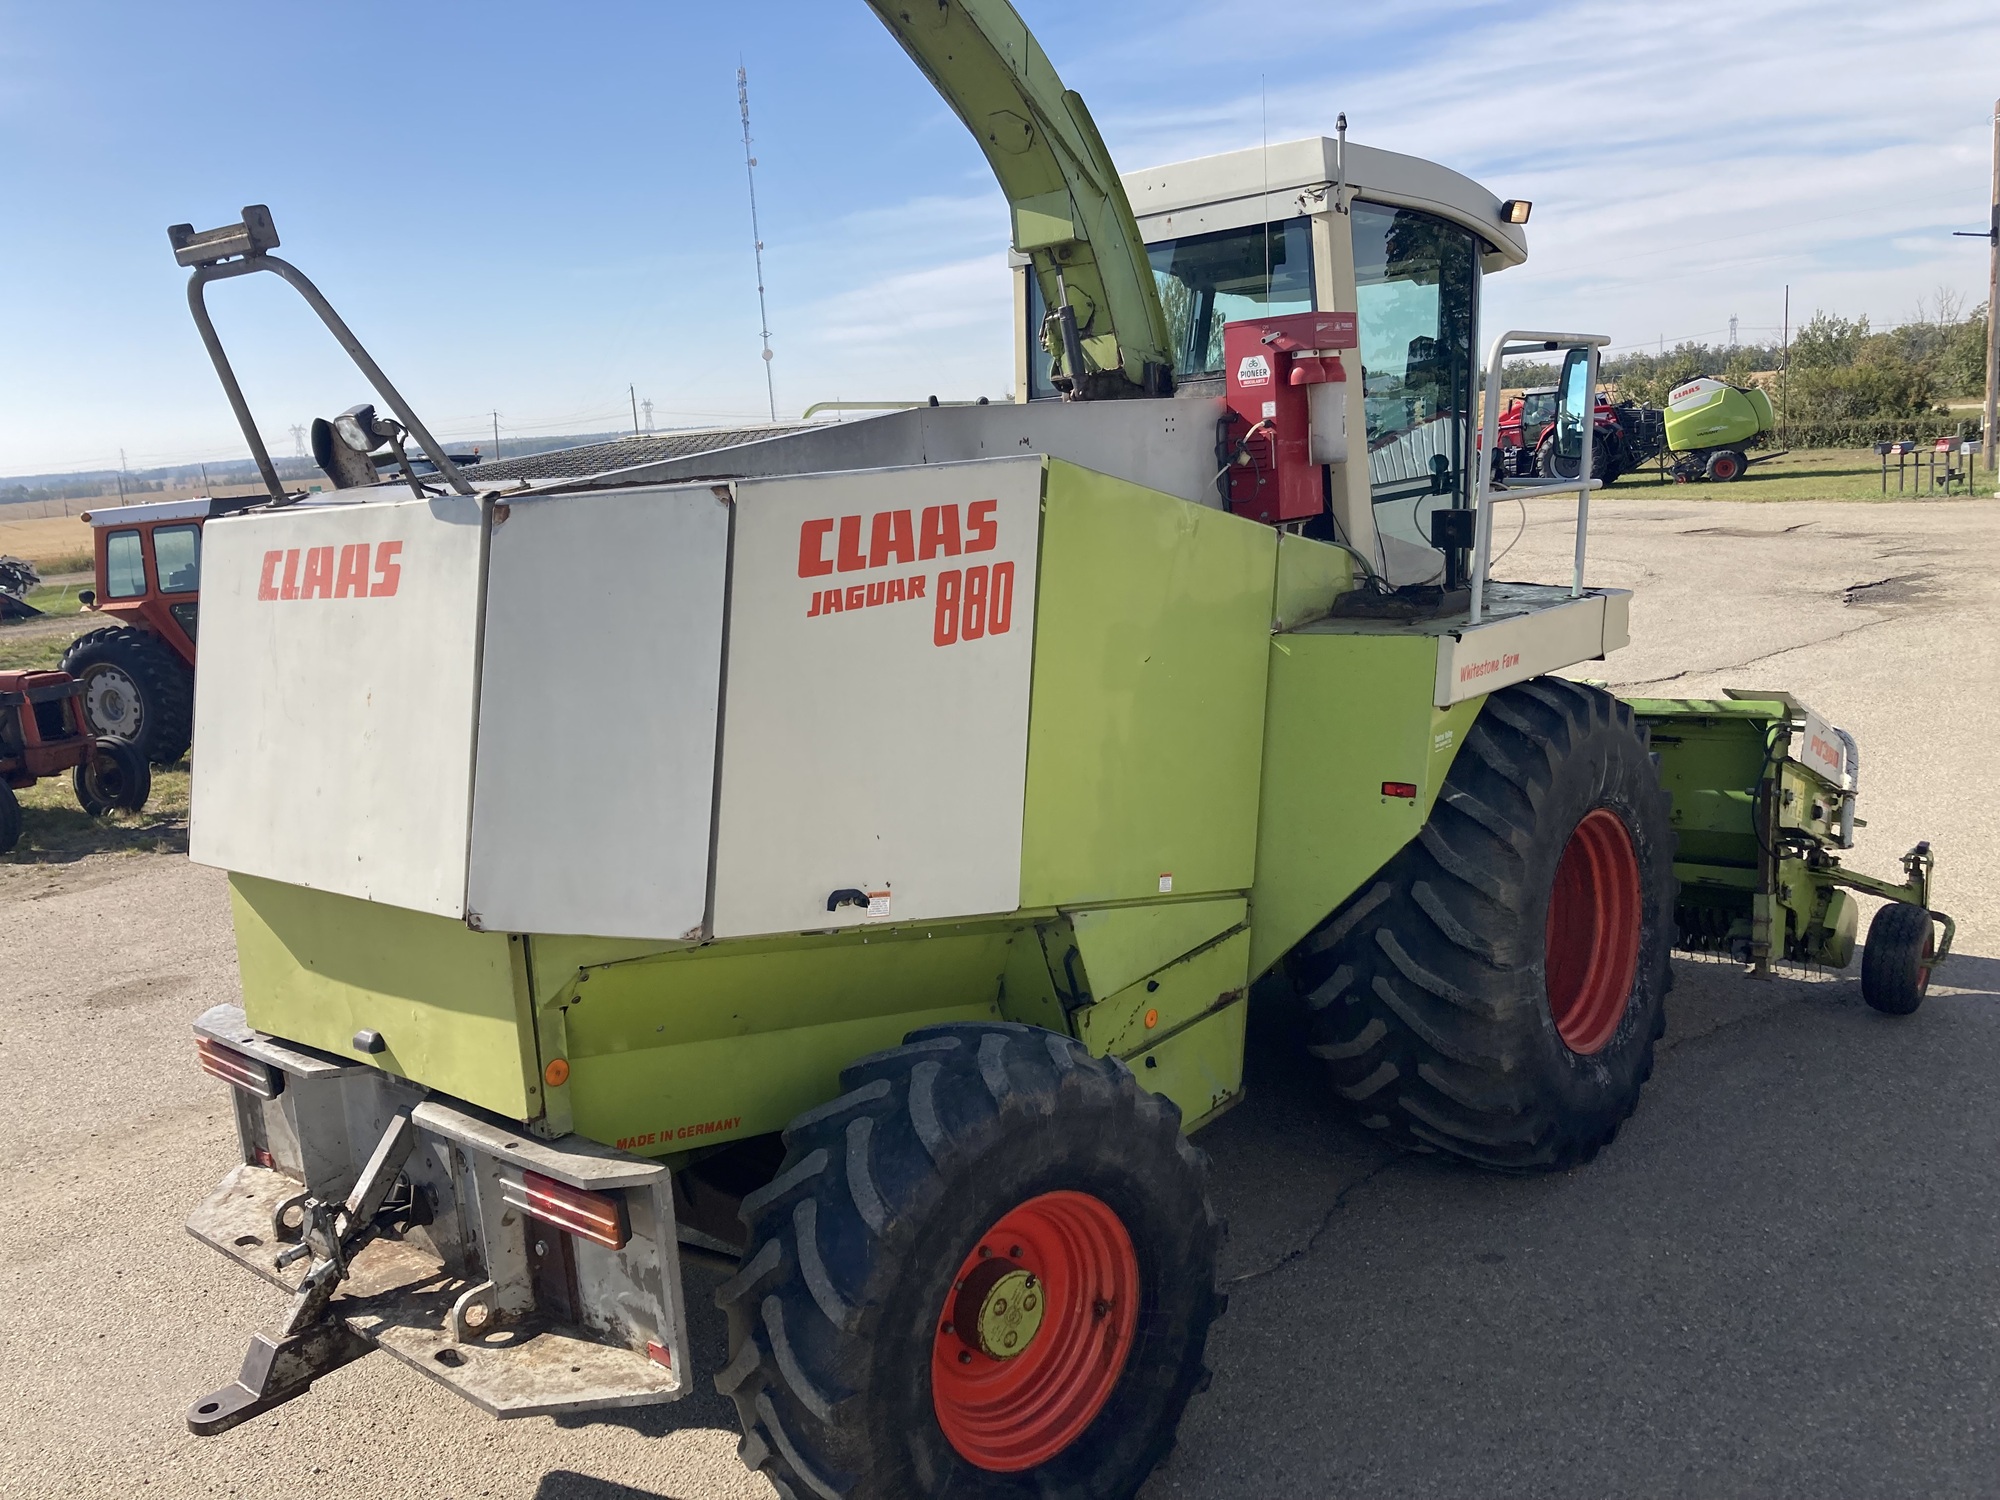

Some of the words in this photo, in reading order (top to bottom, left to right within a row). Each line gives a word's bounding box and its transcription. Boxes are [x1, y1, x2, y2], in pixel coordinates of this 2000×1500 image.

[1240, 368, 1268, 378] PIONEER
[1674, 385, 1700, 399] CLAAS
[798, 499, 998, 578] CLAAS
[258, 541, 403, 601] CLAAS
[807, 575, 926, 618] JAGUAR
[933, 561, 1014, 647] 880
[1460, 659, 1499, 683] Whitestone
[1502, 653, 1520, 669] Farm
[616, 1133, 656, 1150] MADE
[660, 1129, 674, 1142] IN
[677, 1117, 742, 1139] GERMANY
